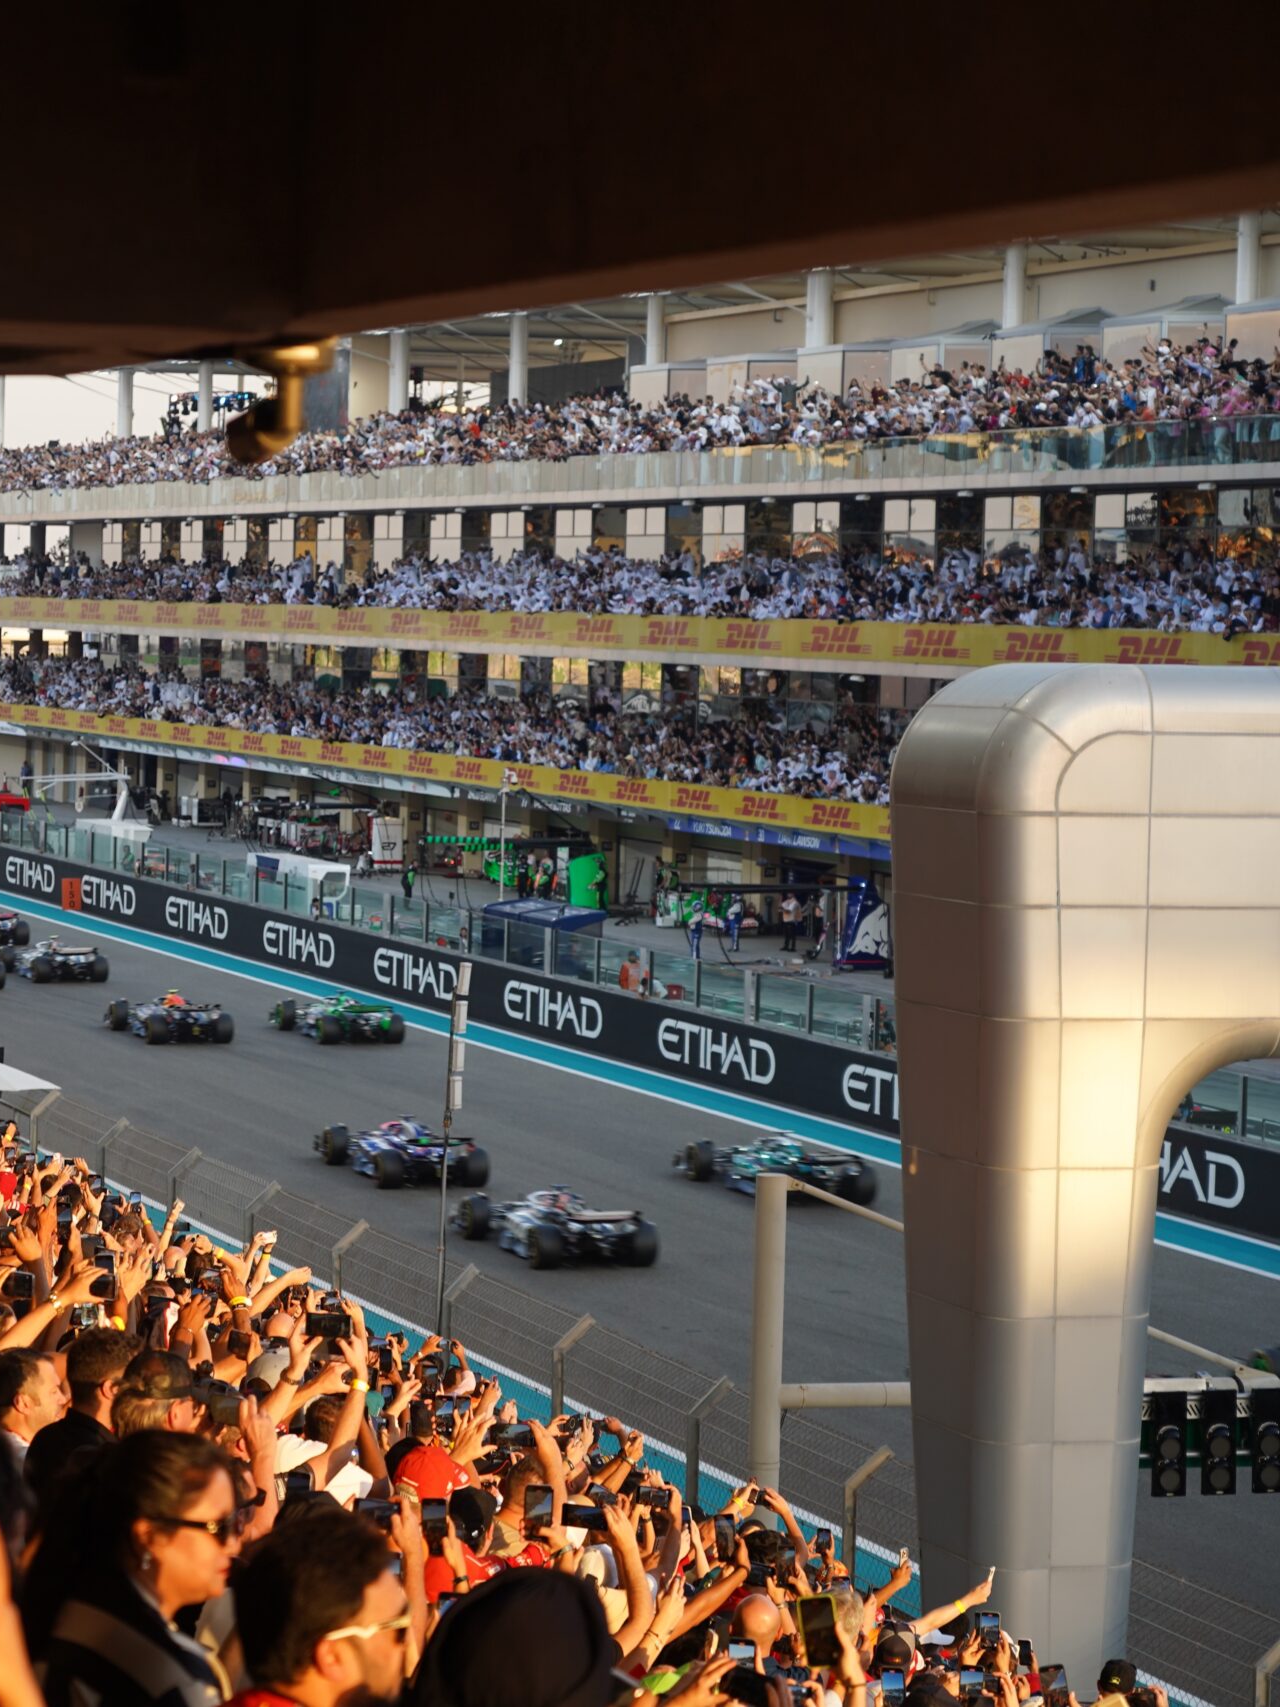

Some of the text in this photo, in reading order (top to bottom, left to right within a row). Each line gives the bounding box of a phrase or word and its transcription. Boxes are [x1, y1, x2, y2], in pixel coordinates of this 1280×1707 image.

[286, 609, 315, 630] DHL
[336, 610, 368, 632] DHL
[390, 613, 422, 634] DHL
[447, 614, 482, 637] DHL
[509, 616, 546, 640] DHL
[575, 618, 616, 643] DHL
[648, 621, 690, 646] DHL
[726, 623, 771, 649] DHL
[810, 626, 863, 653] DHL
[903, 628, 959, 659] DHL
[1004, 632, 1065, 663] DHL
[1118, 636, 1183, 665] DHL
[1243, 641, 1280, 666] D
[322, 743, 344, 763] DHL
[364, 748, 387, 768] DHL
[408, 752, 435, 775] DHL
[455, 760, 483, 781] DHL
[559, 772, 591, 795] DHL
[617, 780, 649, 803] DHL
[677, 788, 713, 812] DHL
[742, 795, 780, 819] DHL
[812, 803, 852, 829] DHL
[5, 856, 55, 893] ETIHAD
[81, 873, 136, 916] ETIHAD
[165, 895, 228, 940] ETIHAD
[263, 920, 335, 968] ETIHAD
[373, 946, 457, 1001] ETIHAD
[504, 979, 603, 1039] ETIHAD
[658, 1017, 776, 1085] ETIHAD
